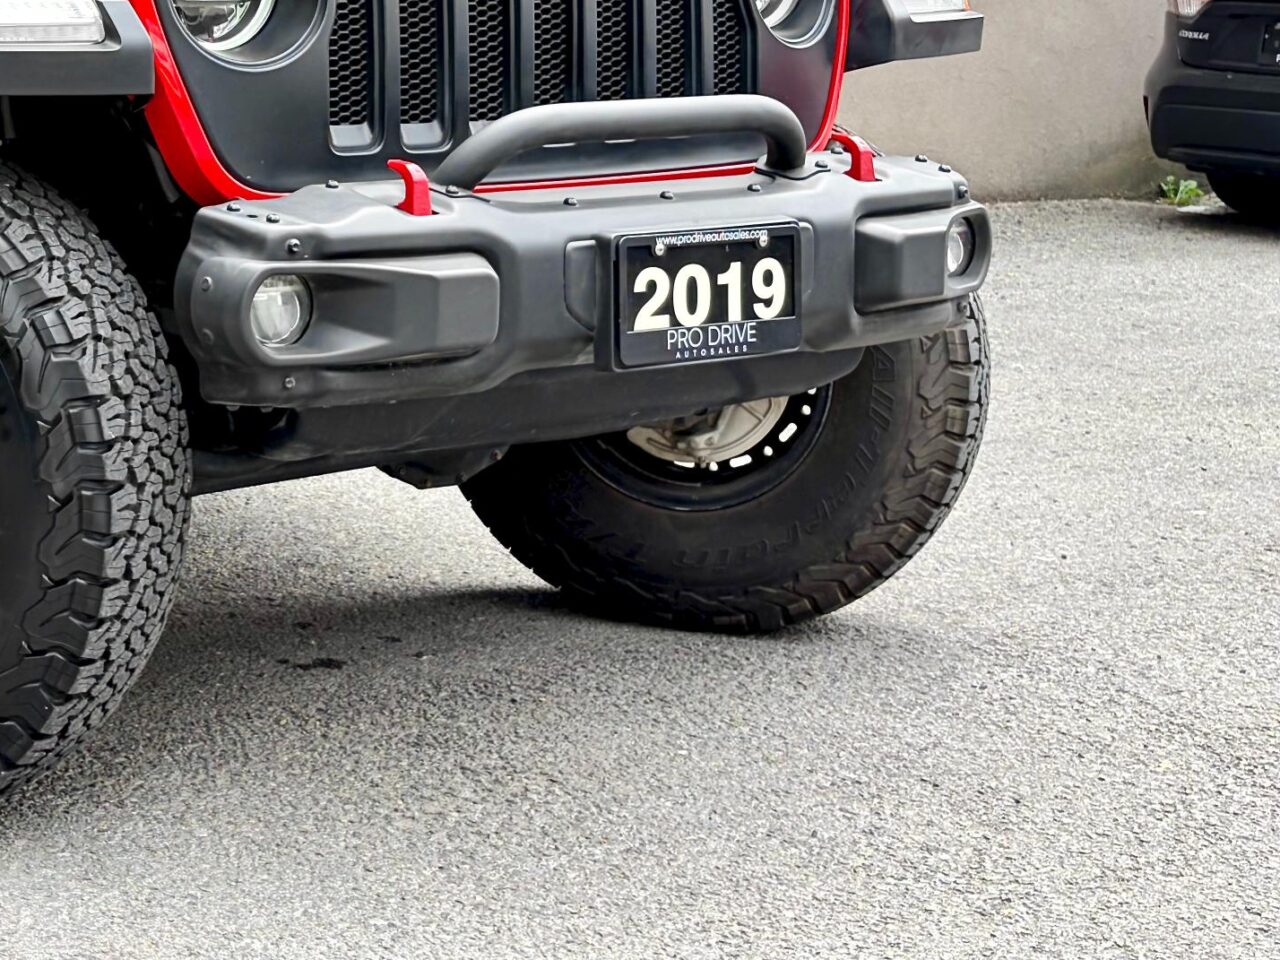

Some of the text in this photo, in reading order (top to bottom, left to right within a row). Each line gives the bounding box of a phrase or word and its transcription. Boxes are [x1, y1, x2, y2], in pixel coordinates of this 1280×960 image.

[655, 229, 768, 247] www.prodriveautosales.com
[633, 257, 786, 331] 2019
[667, 322, 757, 350] PRO DRIVE
[675, 344, 748, 359] AUTOSALES
